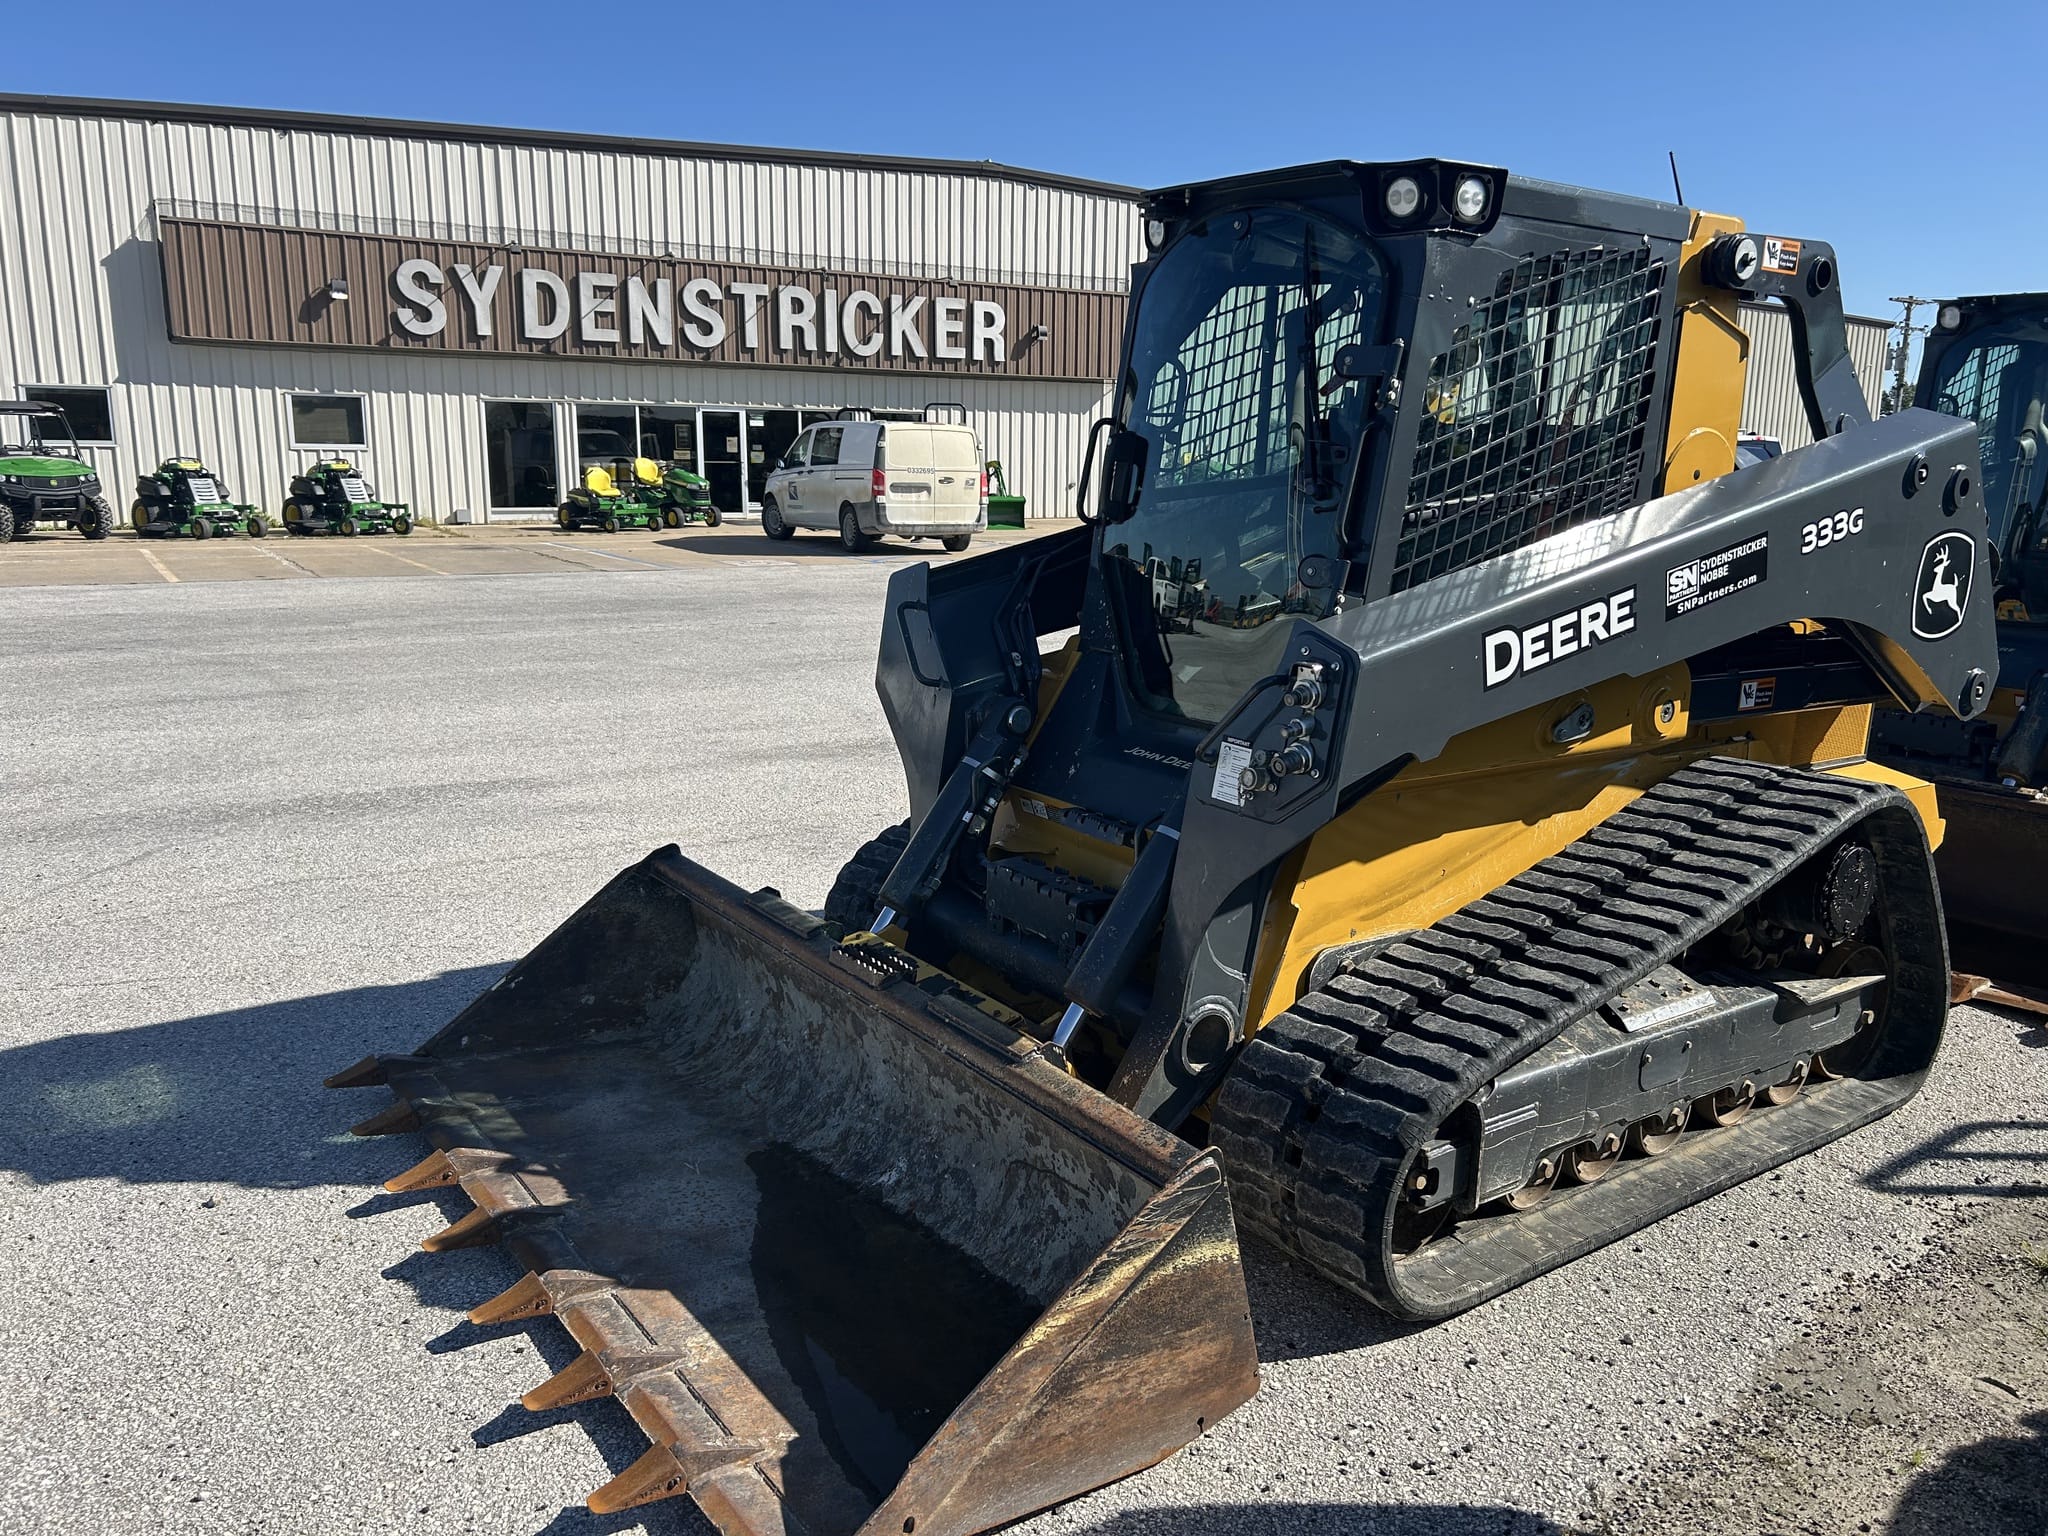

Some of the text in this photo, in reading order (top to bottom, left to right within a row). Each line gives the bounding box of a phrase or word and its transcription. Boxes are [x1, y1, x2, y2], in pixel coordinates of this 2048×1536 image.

[396, 259, 1005, 361] SYDENSTRICKER
[1801, 507, 1864, 554] 333G
[1700, 536, 1768, 572] SYDENSTRICKER
[1669, 564, 1698, 593] SN
[1669, 585, 1697, 601] PARTNERS
[1700, 564, 1729, 586] NOBBE
[1677, 573, 1757, 614] SNPartners.com
[1484, 588, 1636, 688] DEERE
[1123, 746, 1166, 761] JOHN
